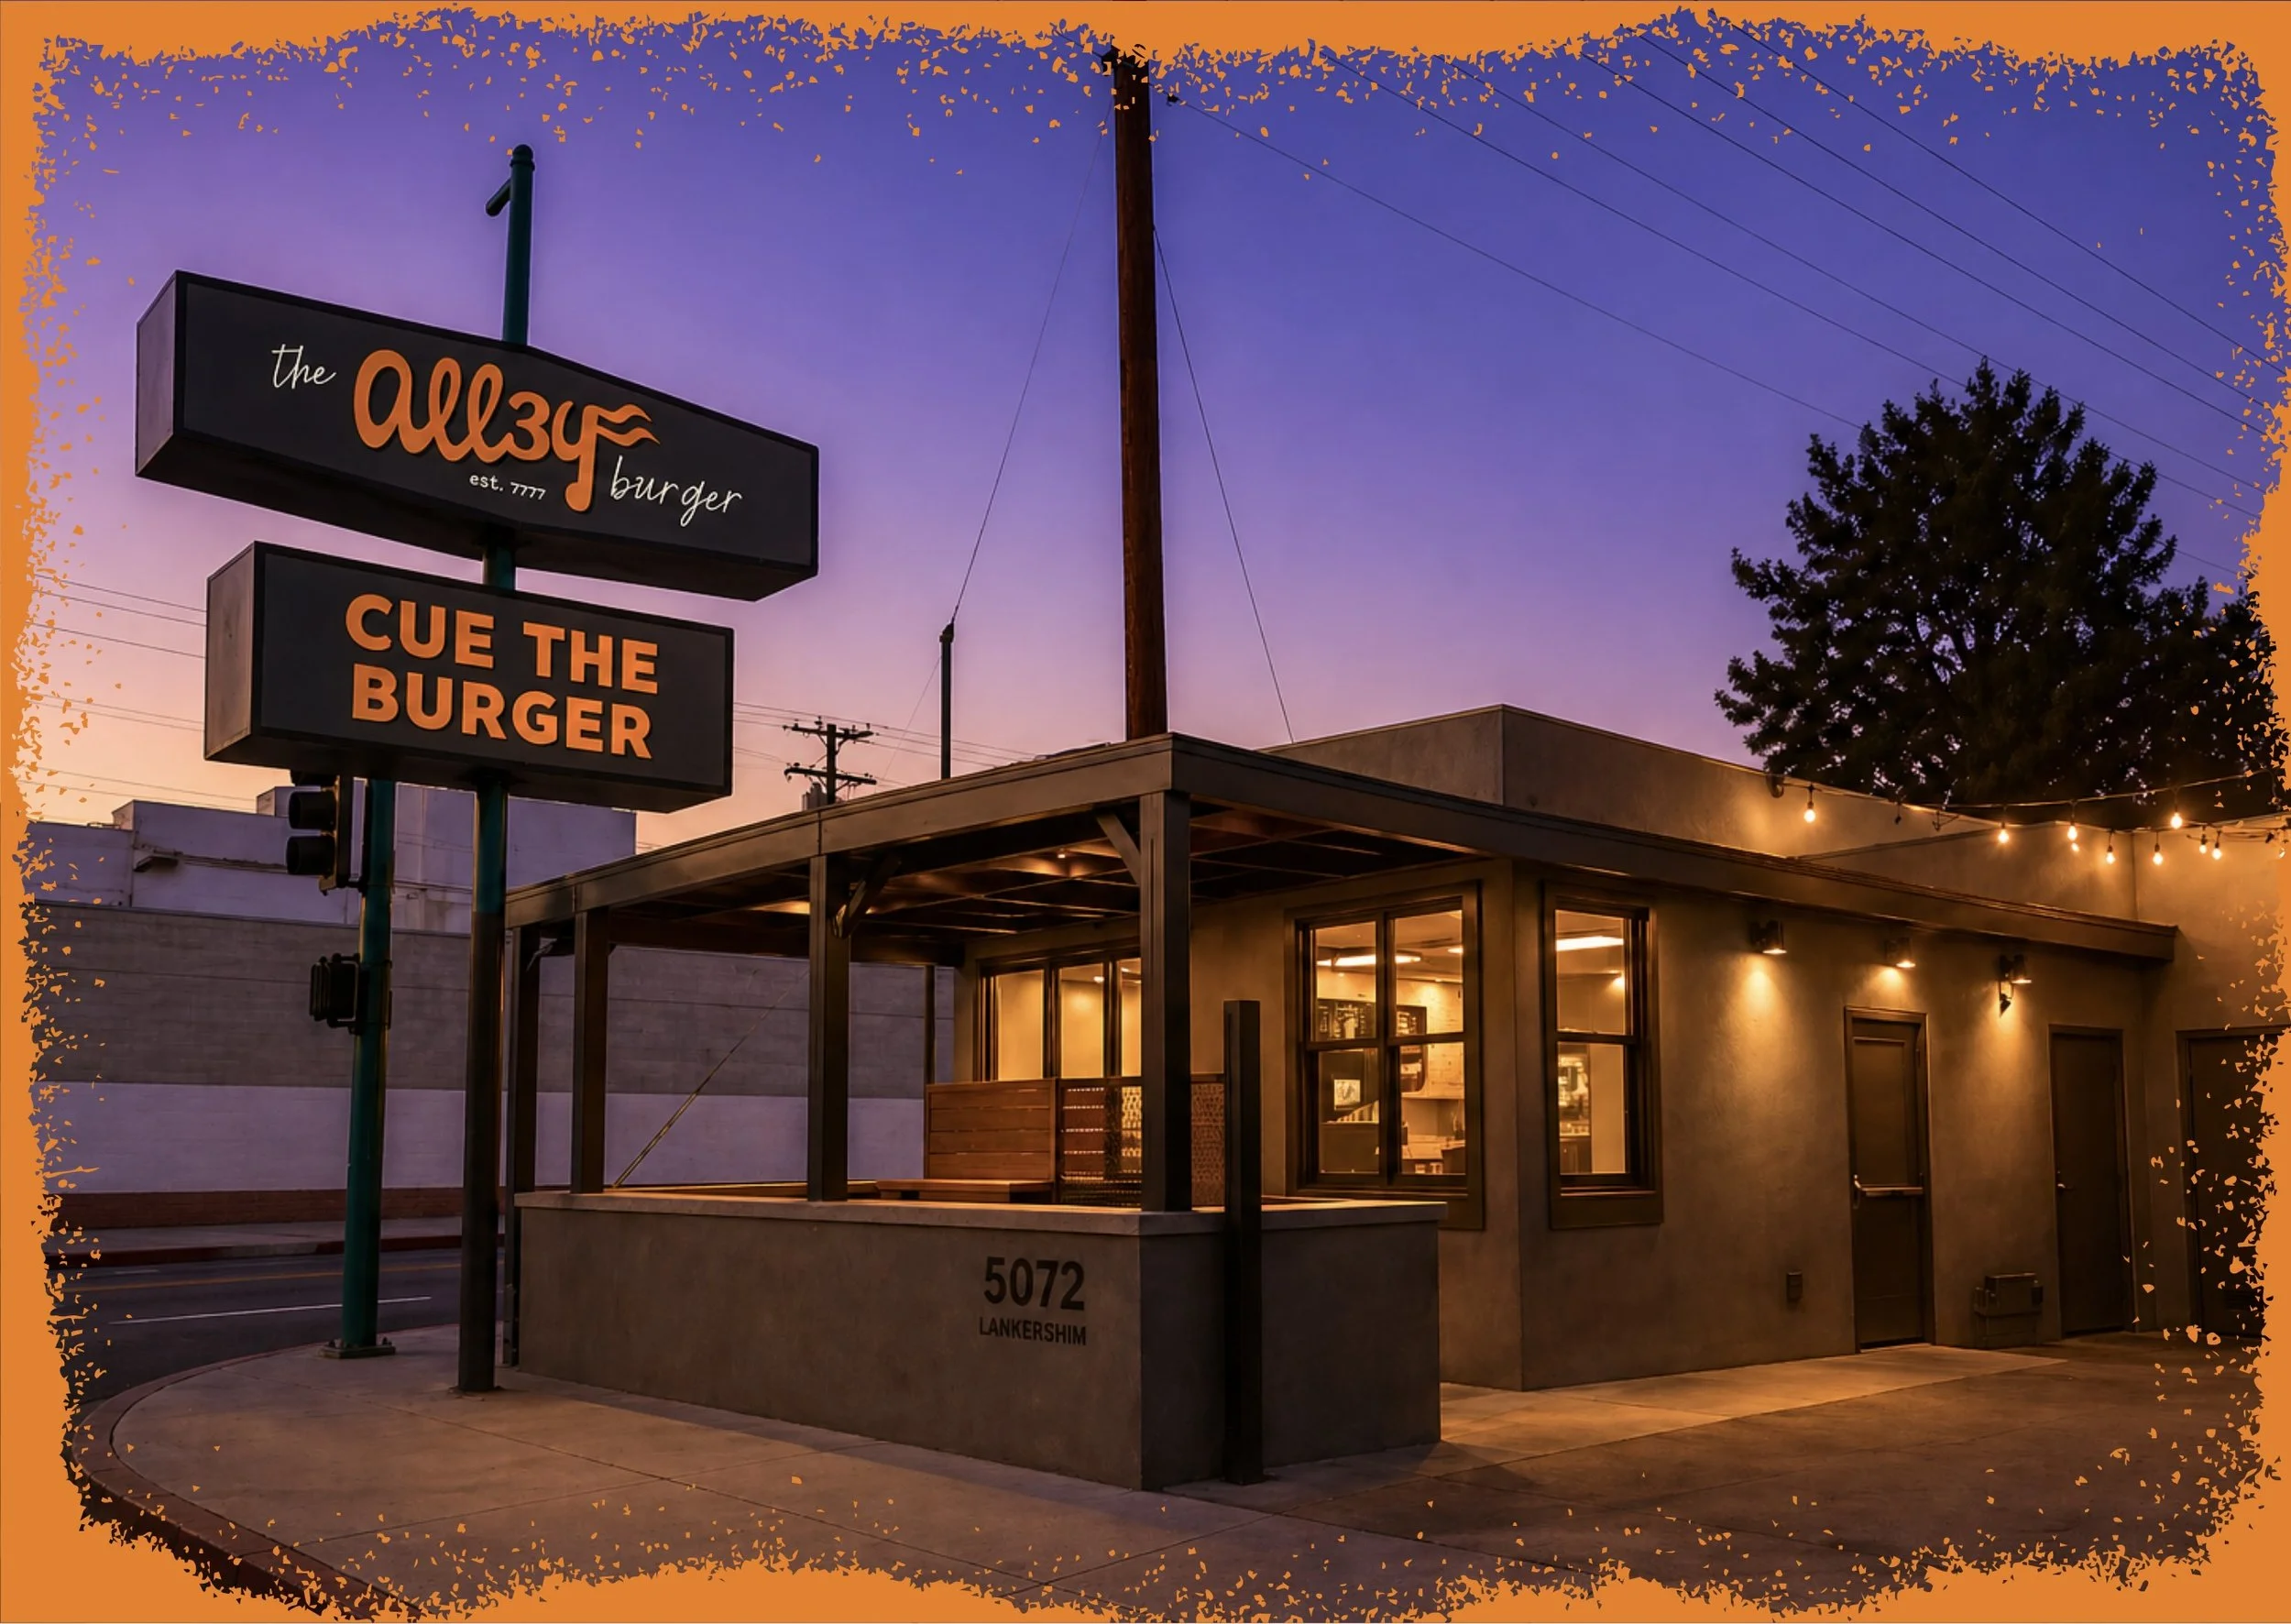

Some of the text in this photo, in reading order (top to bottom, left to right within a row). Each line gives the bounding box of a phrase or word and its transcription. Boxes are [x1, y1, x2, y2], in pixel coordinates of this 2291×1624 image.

[270, 343, 336, 390] the
[468, 474, 547, 501] est. 7777
[610, 455, 742, 528] burger
[345, 593, 659, 695] CUE THE
[351, 663, 652, 760] BURGER
[983, 1256, 1085, 1311] 5072
[979, 1316, 1087, 1345] LANKERSHIM
